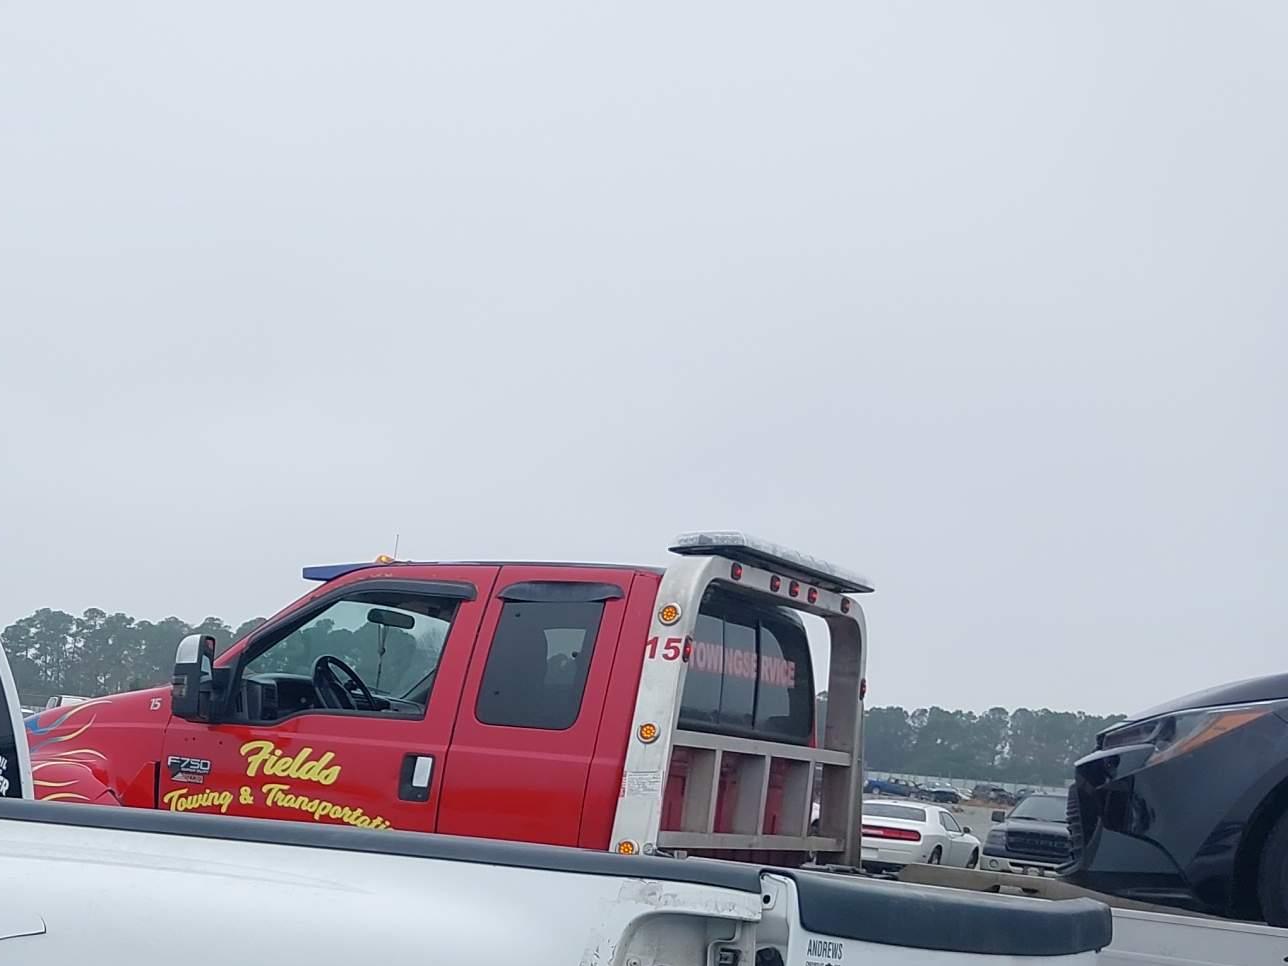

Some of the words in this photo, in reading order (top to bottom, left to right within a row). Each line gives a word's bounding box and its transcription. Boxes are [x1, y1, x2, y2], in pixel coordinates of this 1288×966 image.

[150, 698, 162, 710] 15
[240, 741, 341, 785] Fields
[163, 788, 233, 812] Towing
[239, 787, 254, 804] &
[807, 939, 843, 960] ANDREWS
